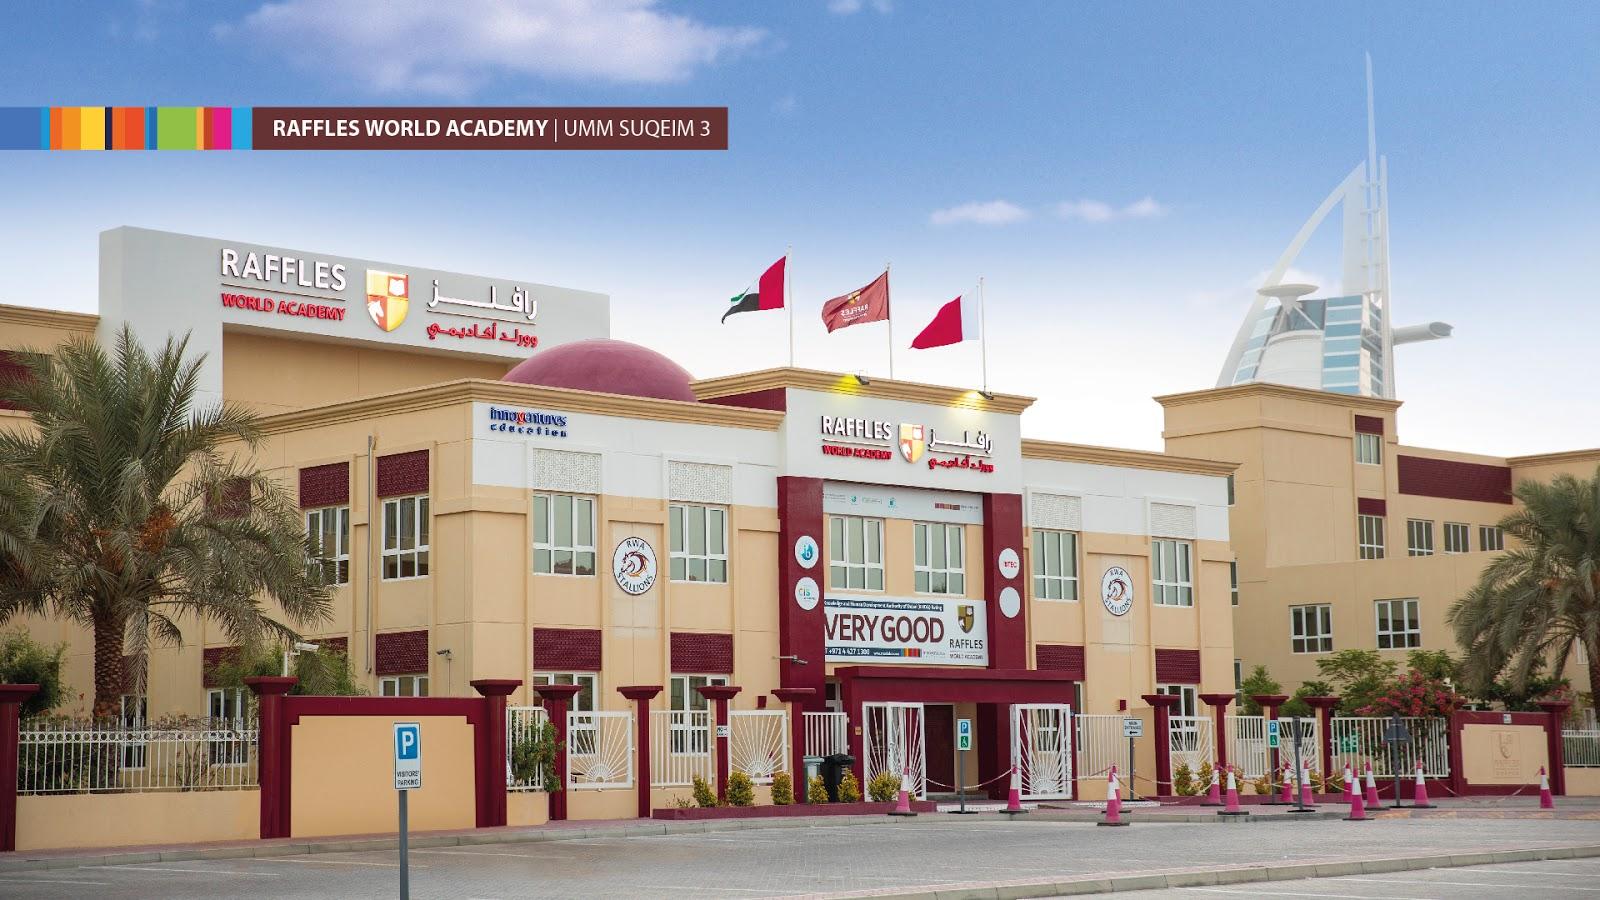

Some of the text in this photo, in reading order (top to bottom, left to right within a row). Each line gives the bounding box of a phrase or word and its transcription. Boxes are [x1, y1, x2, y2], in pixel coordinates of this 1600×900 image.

[221, 248, 347, 291] RAFFLES
[222, 293, 346, 321] WORLD ACADEMY
[821, 415, 893, 441] RAFFLES
[822, 445, 893, 460] WORLD ACADEMY
[626, 539, 646, 550] RWA
[617, 572, 653, 592] STALLIONS
[824, 613, 944, 643] VERY GOOD
[950, 638, 983, 649] RAFFLES
[402, 731, 414, 755] P
